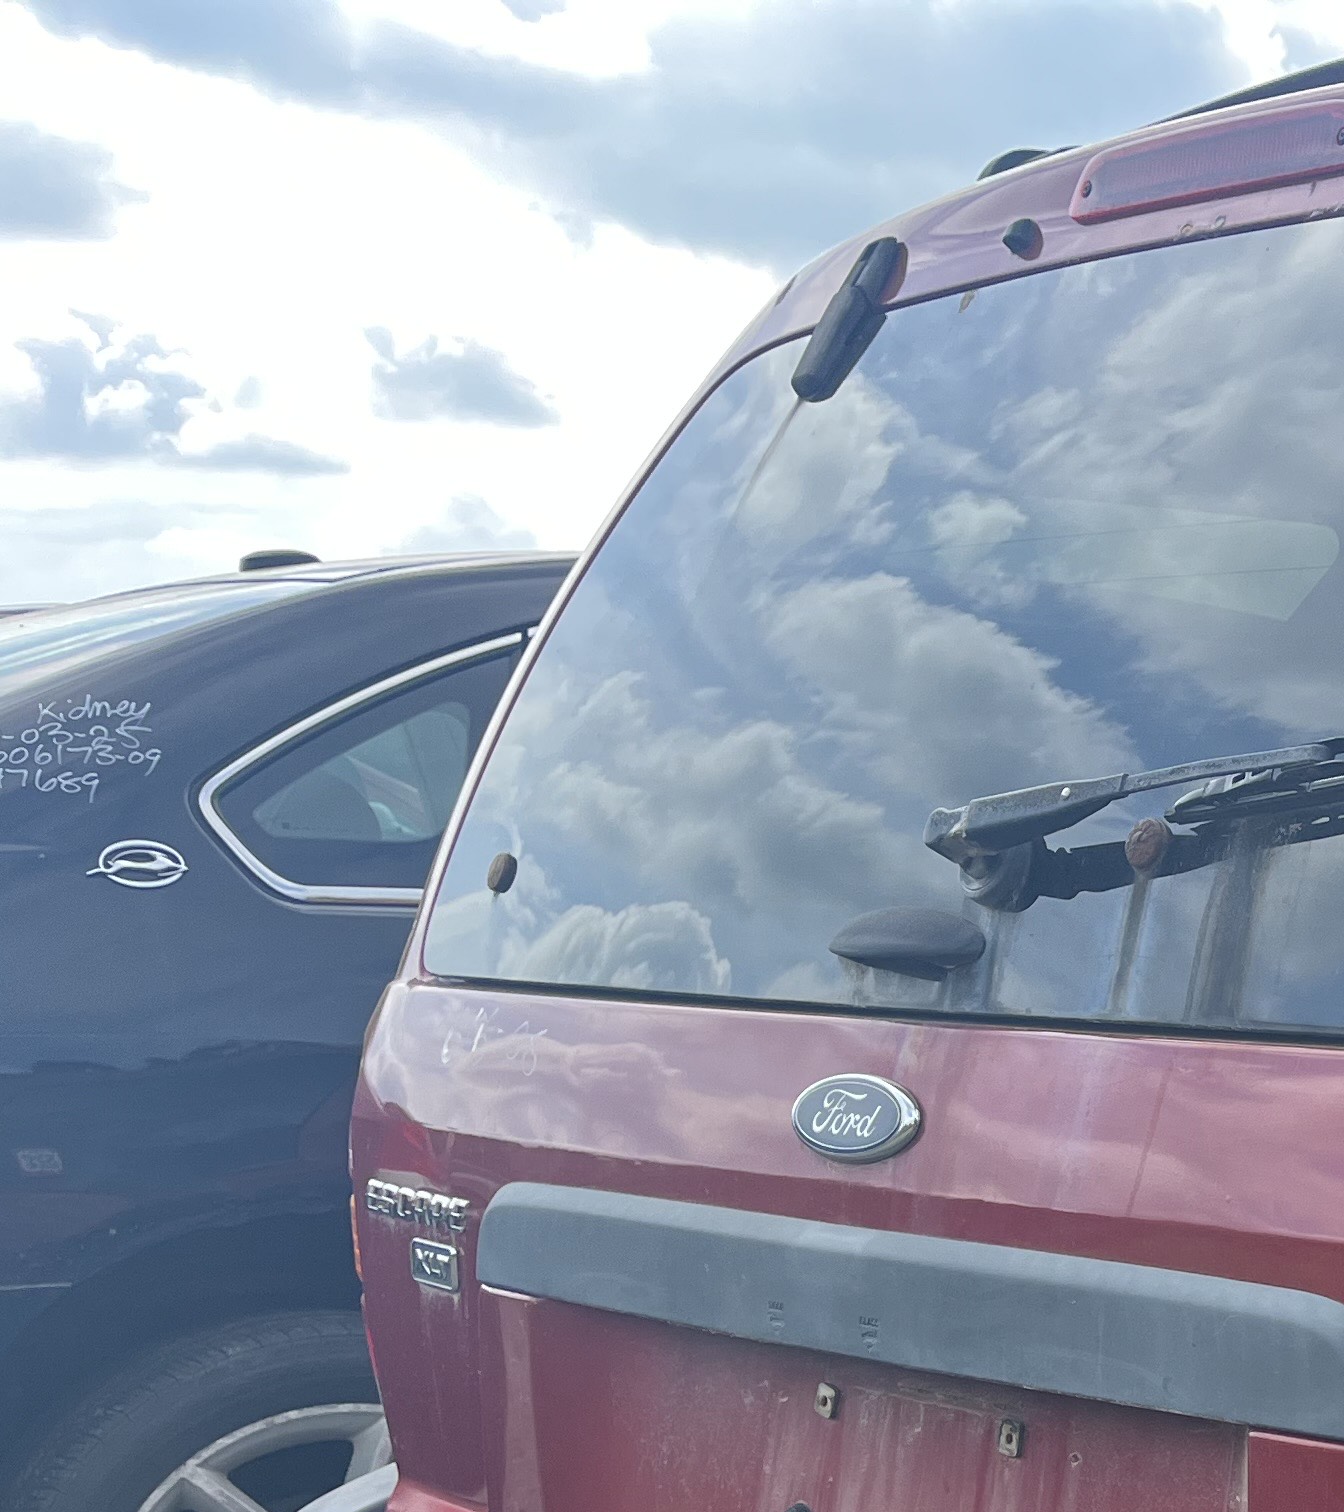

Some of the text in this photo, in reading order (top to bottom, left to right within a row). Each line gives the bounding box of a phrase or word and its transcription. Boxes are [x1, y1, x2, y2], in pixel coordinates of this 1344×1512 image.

[37, 694, 151, 724] Kidney
[812, 1088, 882, 1138] Ford
[414, 1247, 450, 1279] XLT
